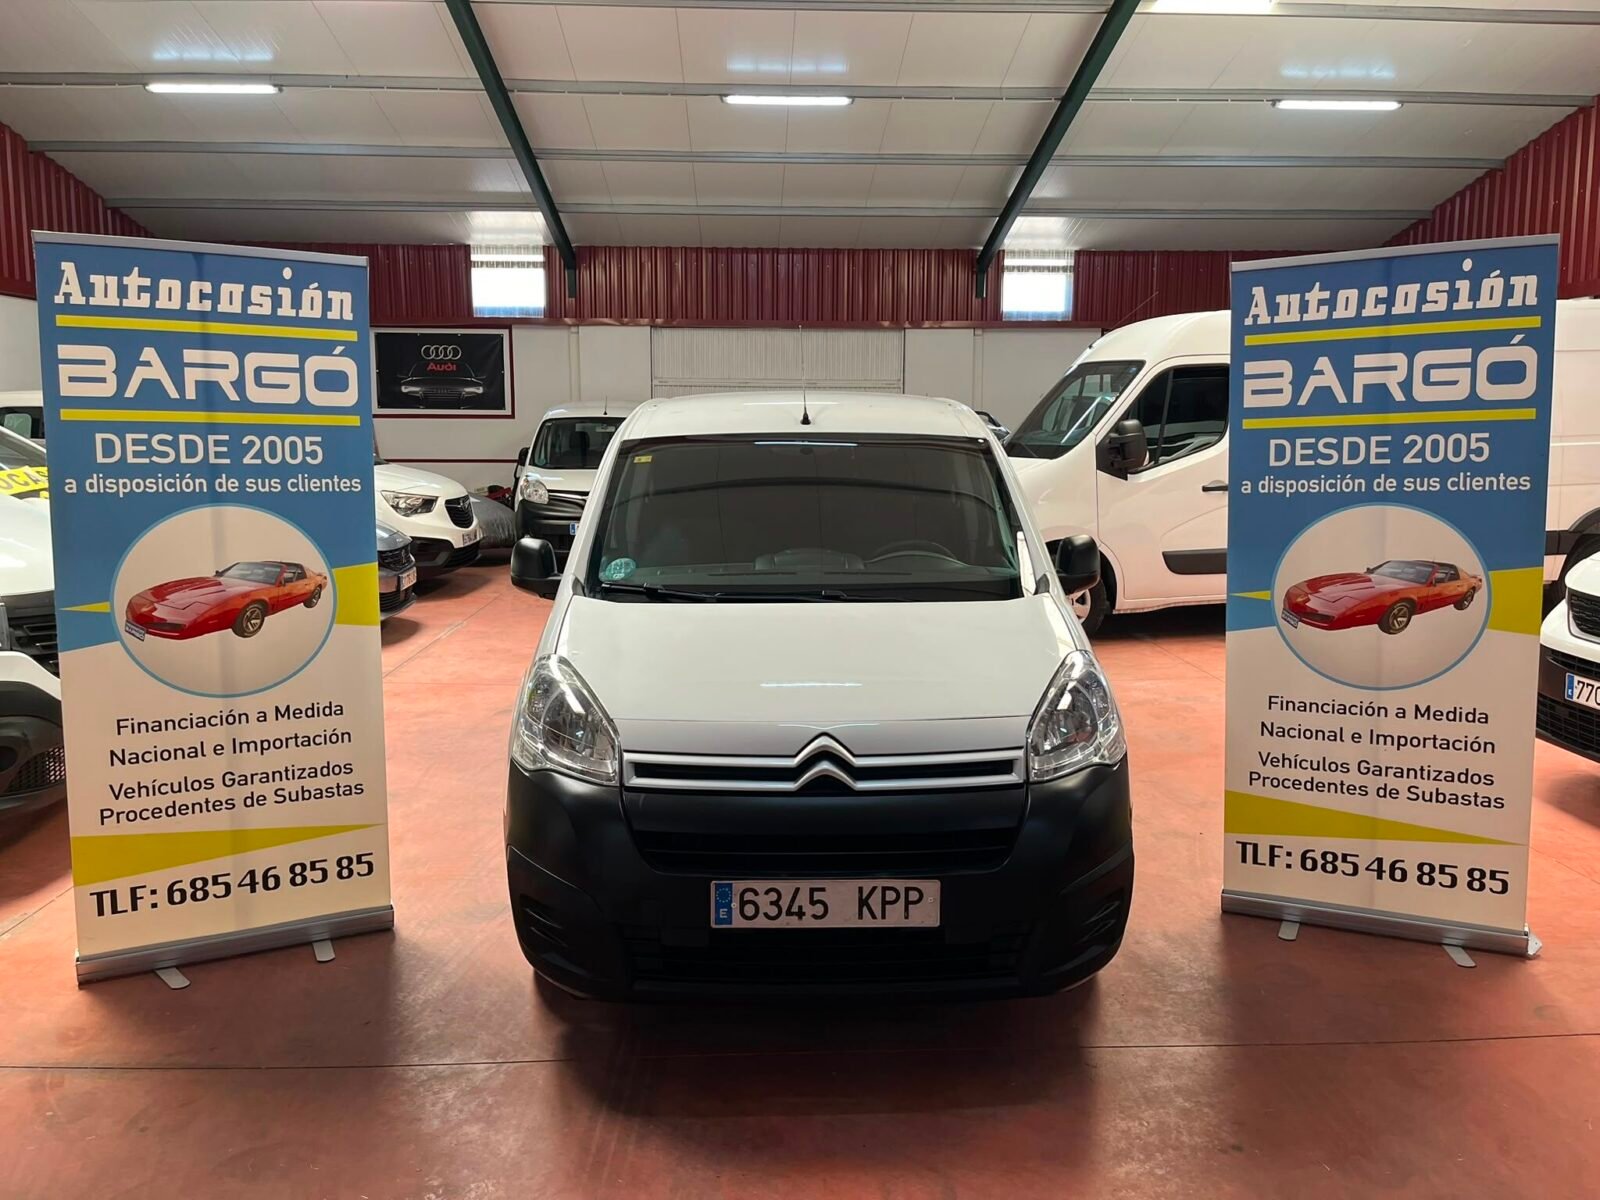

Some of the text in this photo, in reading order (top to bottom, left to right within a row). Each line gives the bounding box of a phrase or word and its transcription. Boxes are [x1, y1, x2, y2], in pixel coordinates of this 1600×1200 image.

[53, 261, 354, 321] Autocasión
[1244, 258, 1538, 325] Autocasión
[56, 344, 359, 407] BARGÓ
[1243, 334, 1538, 408] BARGÓ
[94, 432, 324, 464] DESDE 2005
[1269, 432, 1490, 466] DESDE 2005
[64, 473, 362, 498] a disposición de sus clientes
[1241, 472, 1531, 497] a disposición de sus clientes
[115, 701, 344, 736] Financiación a Medida
[1267, 695, 1490, 724] Financiación a Medida
[109, 728, 352, 766] Nacional e Importación
[1260, 722, 1496, 754] Nacional e Importación
[109, 761, 354, 800] Vehículos Garantizados
[1258, 751, 1495, 787] Vehículos Garantizados
[100, 780, 365, 825] Procedentes de Subastas
[1248, 772, 1505, 810] Procedentes de Subastas
[89, 852, 375, 917] TLF: 685 46 85 85
[1235, 840, 1510, 895] TLF: 685 46 85 85
[719, 885, 925, 921] E 6345 KPP
